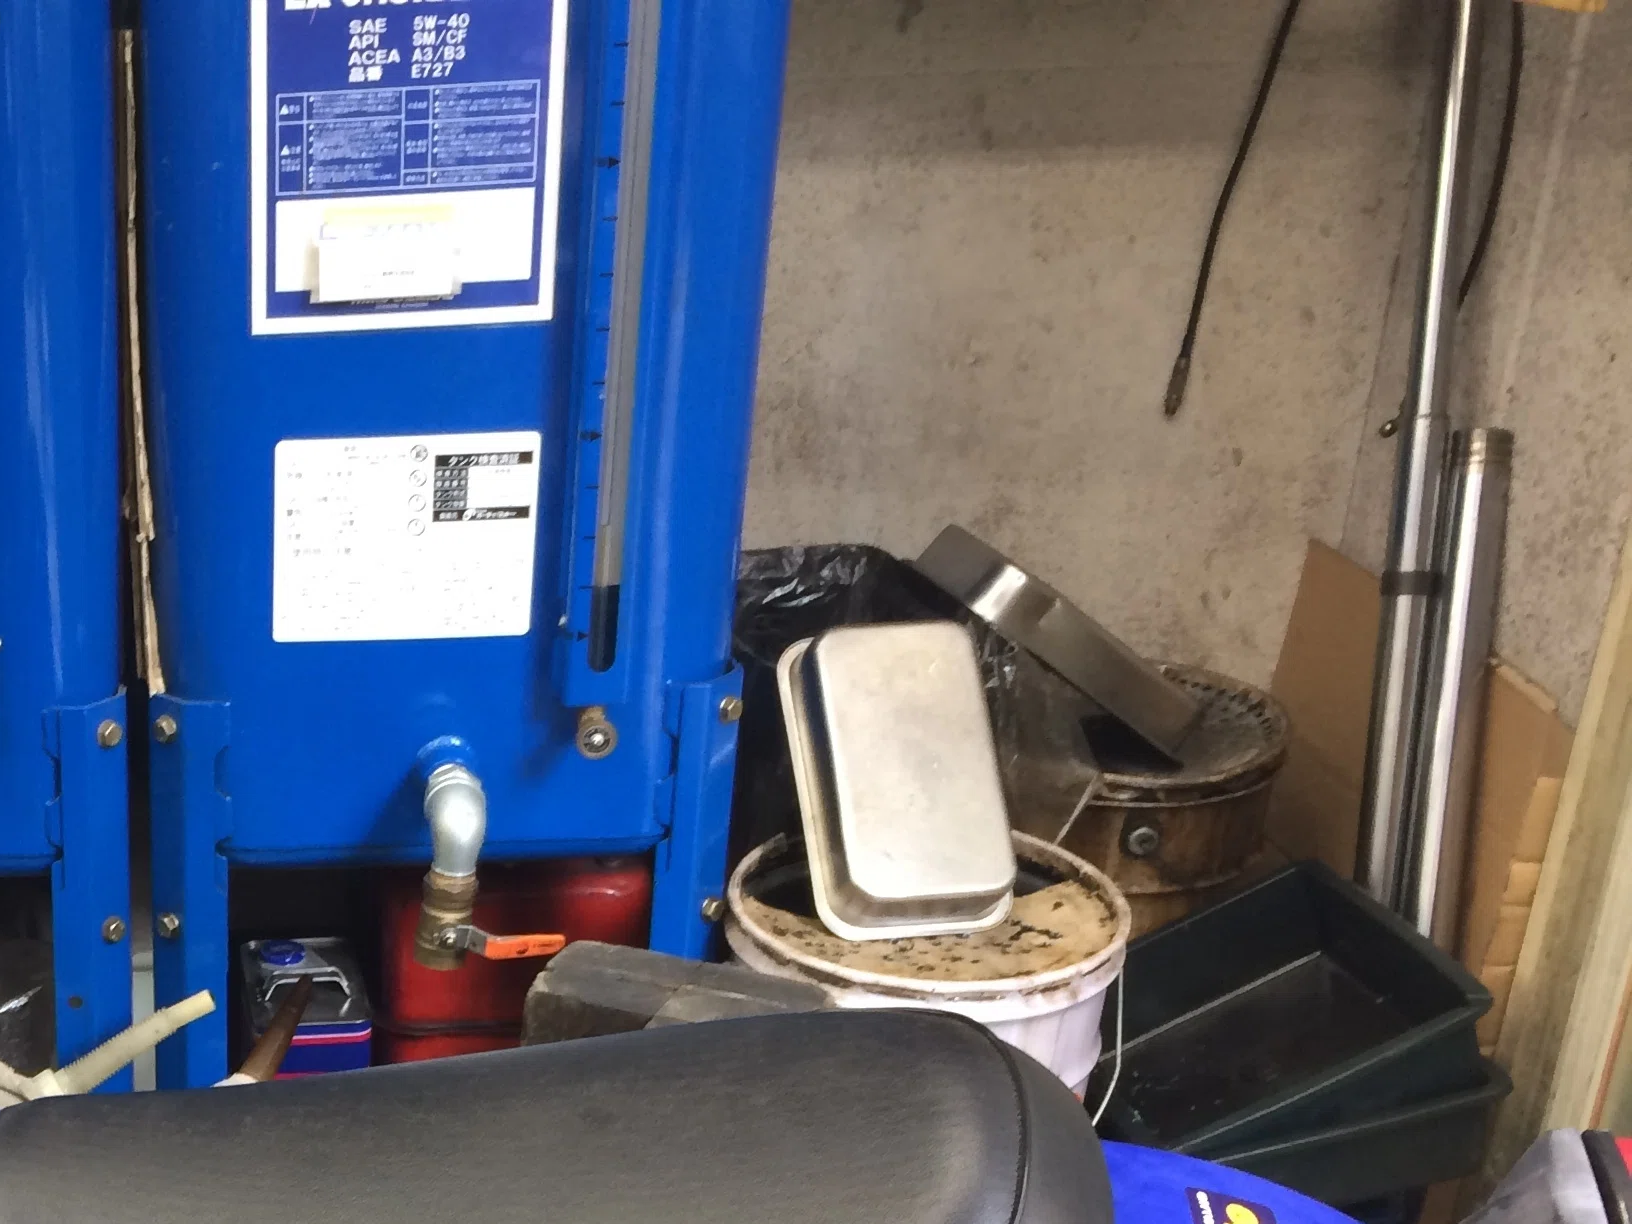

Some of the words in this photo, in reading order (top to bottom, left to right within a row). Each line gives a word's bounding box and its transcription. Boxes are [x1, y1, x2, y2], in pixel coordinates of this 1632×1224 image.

[349, 18, 387, 34] SAE
[413, 13, 470, 31] 5W-40
[349, 34, 380, 50] API
[412, 29, 468, 47] SM/CF
[348, 49, 401, 66] ACEA
[411, 46, 466, 62] A3/B3
[411, 62, 454, 79] E727
